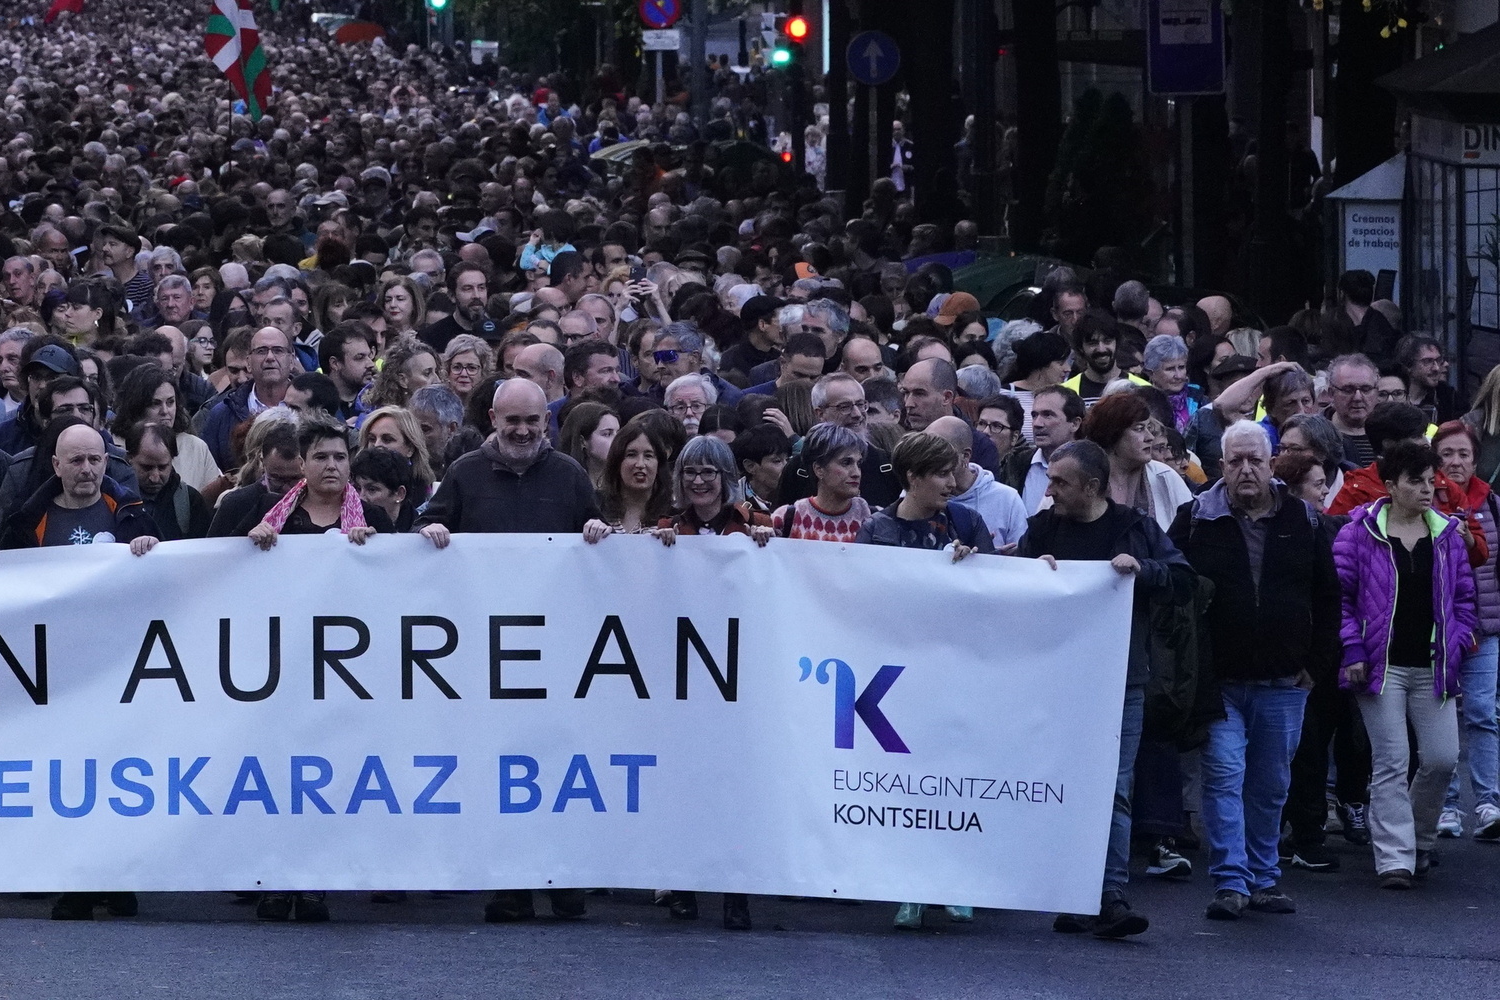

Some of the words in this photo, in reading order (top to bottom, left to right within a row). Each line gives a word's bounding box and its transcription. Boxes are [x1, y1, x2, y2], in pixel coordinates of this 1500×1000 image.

[1352, 213, 1395, 224] Creamos
[1352, 226, 1395, 237] espacios
[1348, 238, 1360, 248] de
[1363, 238, 1400, 250] trabajo
[119, 614, 741, 704] AURREAN
[499, 753, 658, 814] BAT
[832, 769, 1064, 805] EUSKALGINTZAREN
[832, 803, 983, 833] KONTSEILUA
